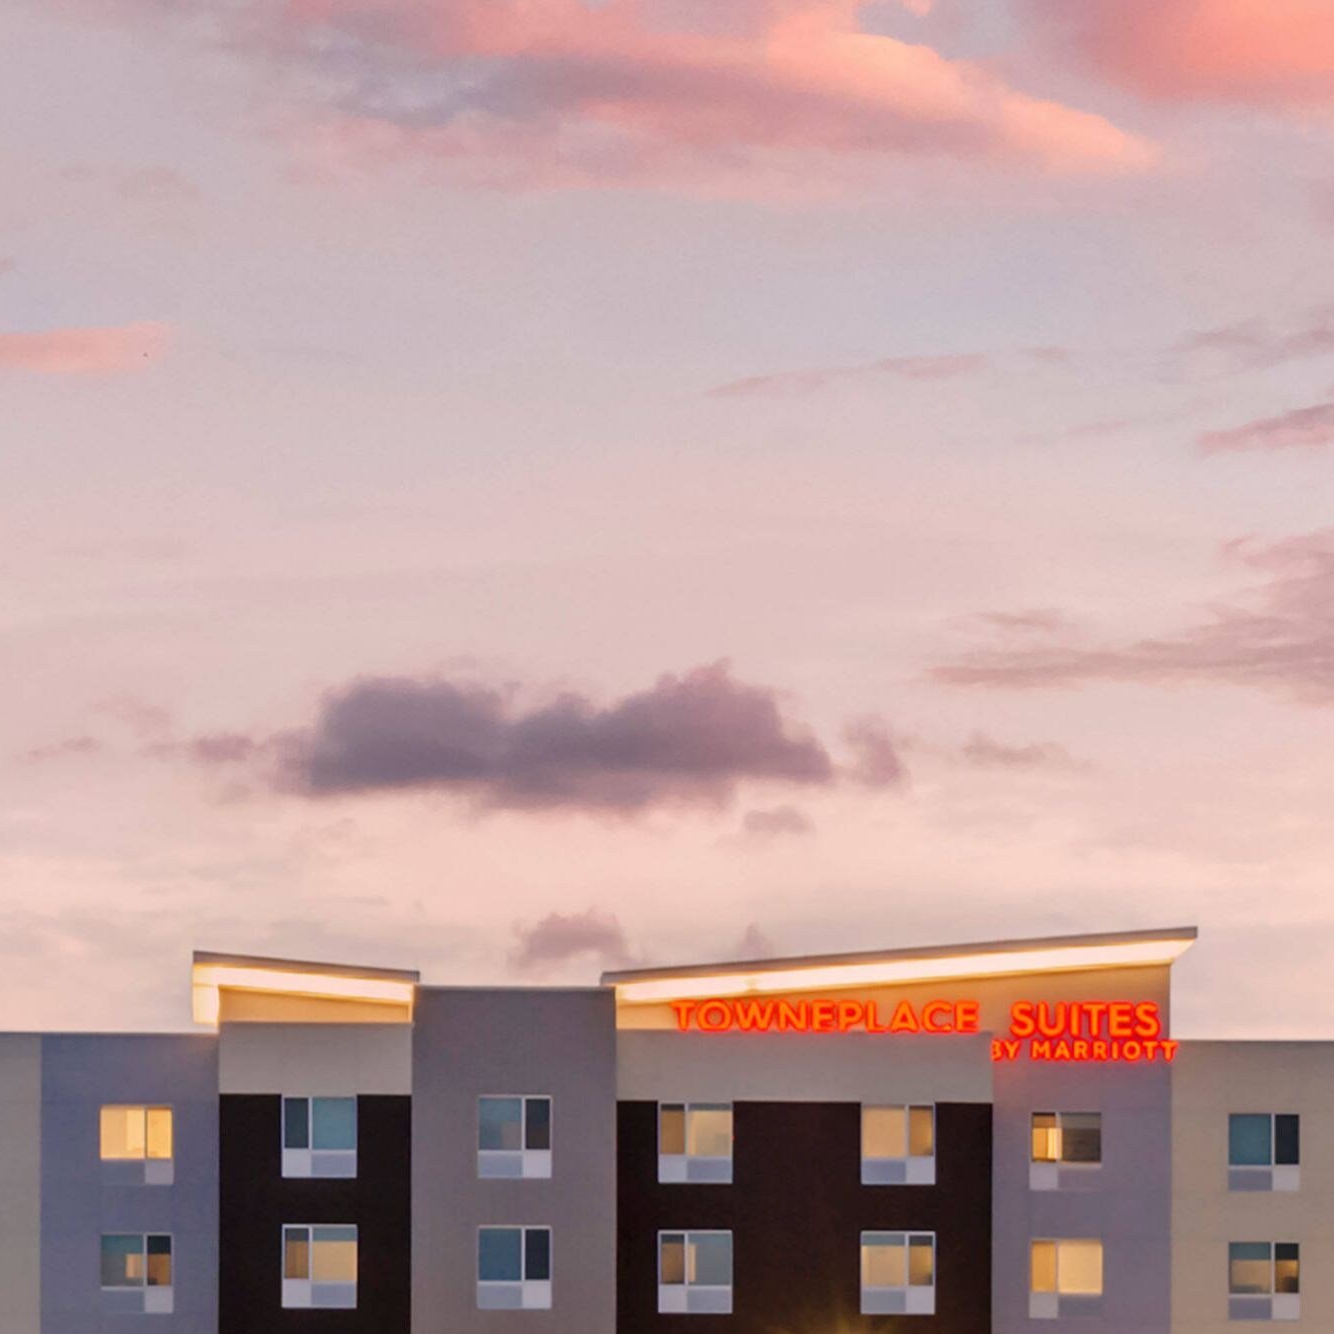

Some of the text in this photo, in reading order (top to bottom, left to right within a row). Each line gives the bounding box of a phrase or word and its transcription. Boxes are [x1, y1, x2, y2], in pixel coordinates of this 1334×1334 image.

[671, 1000, 1161, 1037] TOWNEPLACE SUITES
[991, 1040, 1178, 1061] BY MARRIOTT
